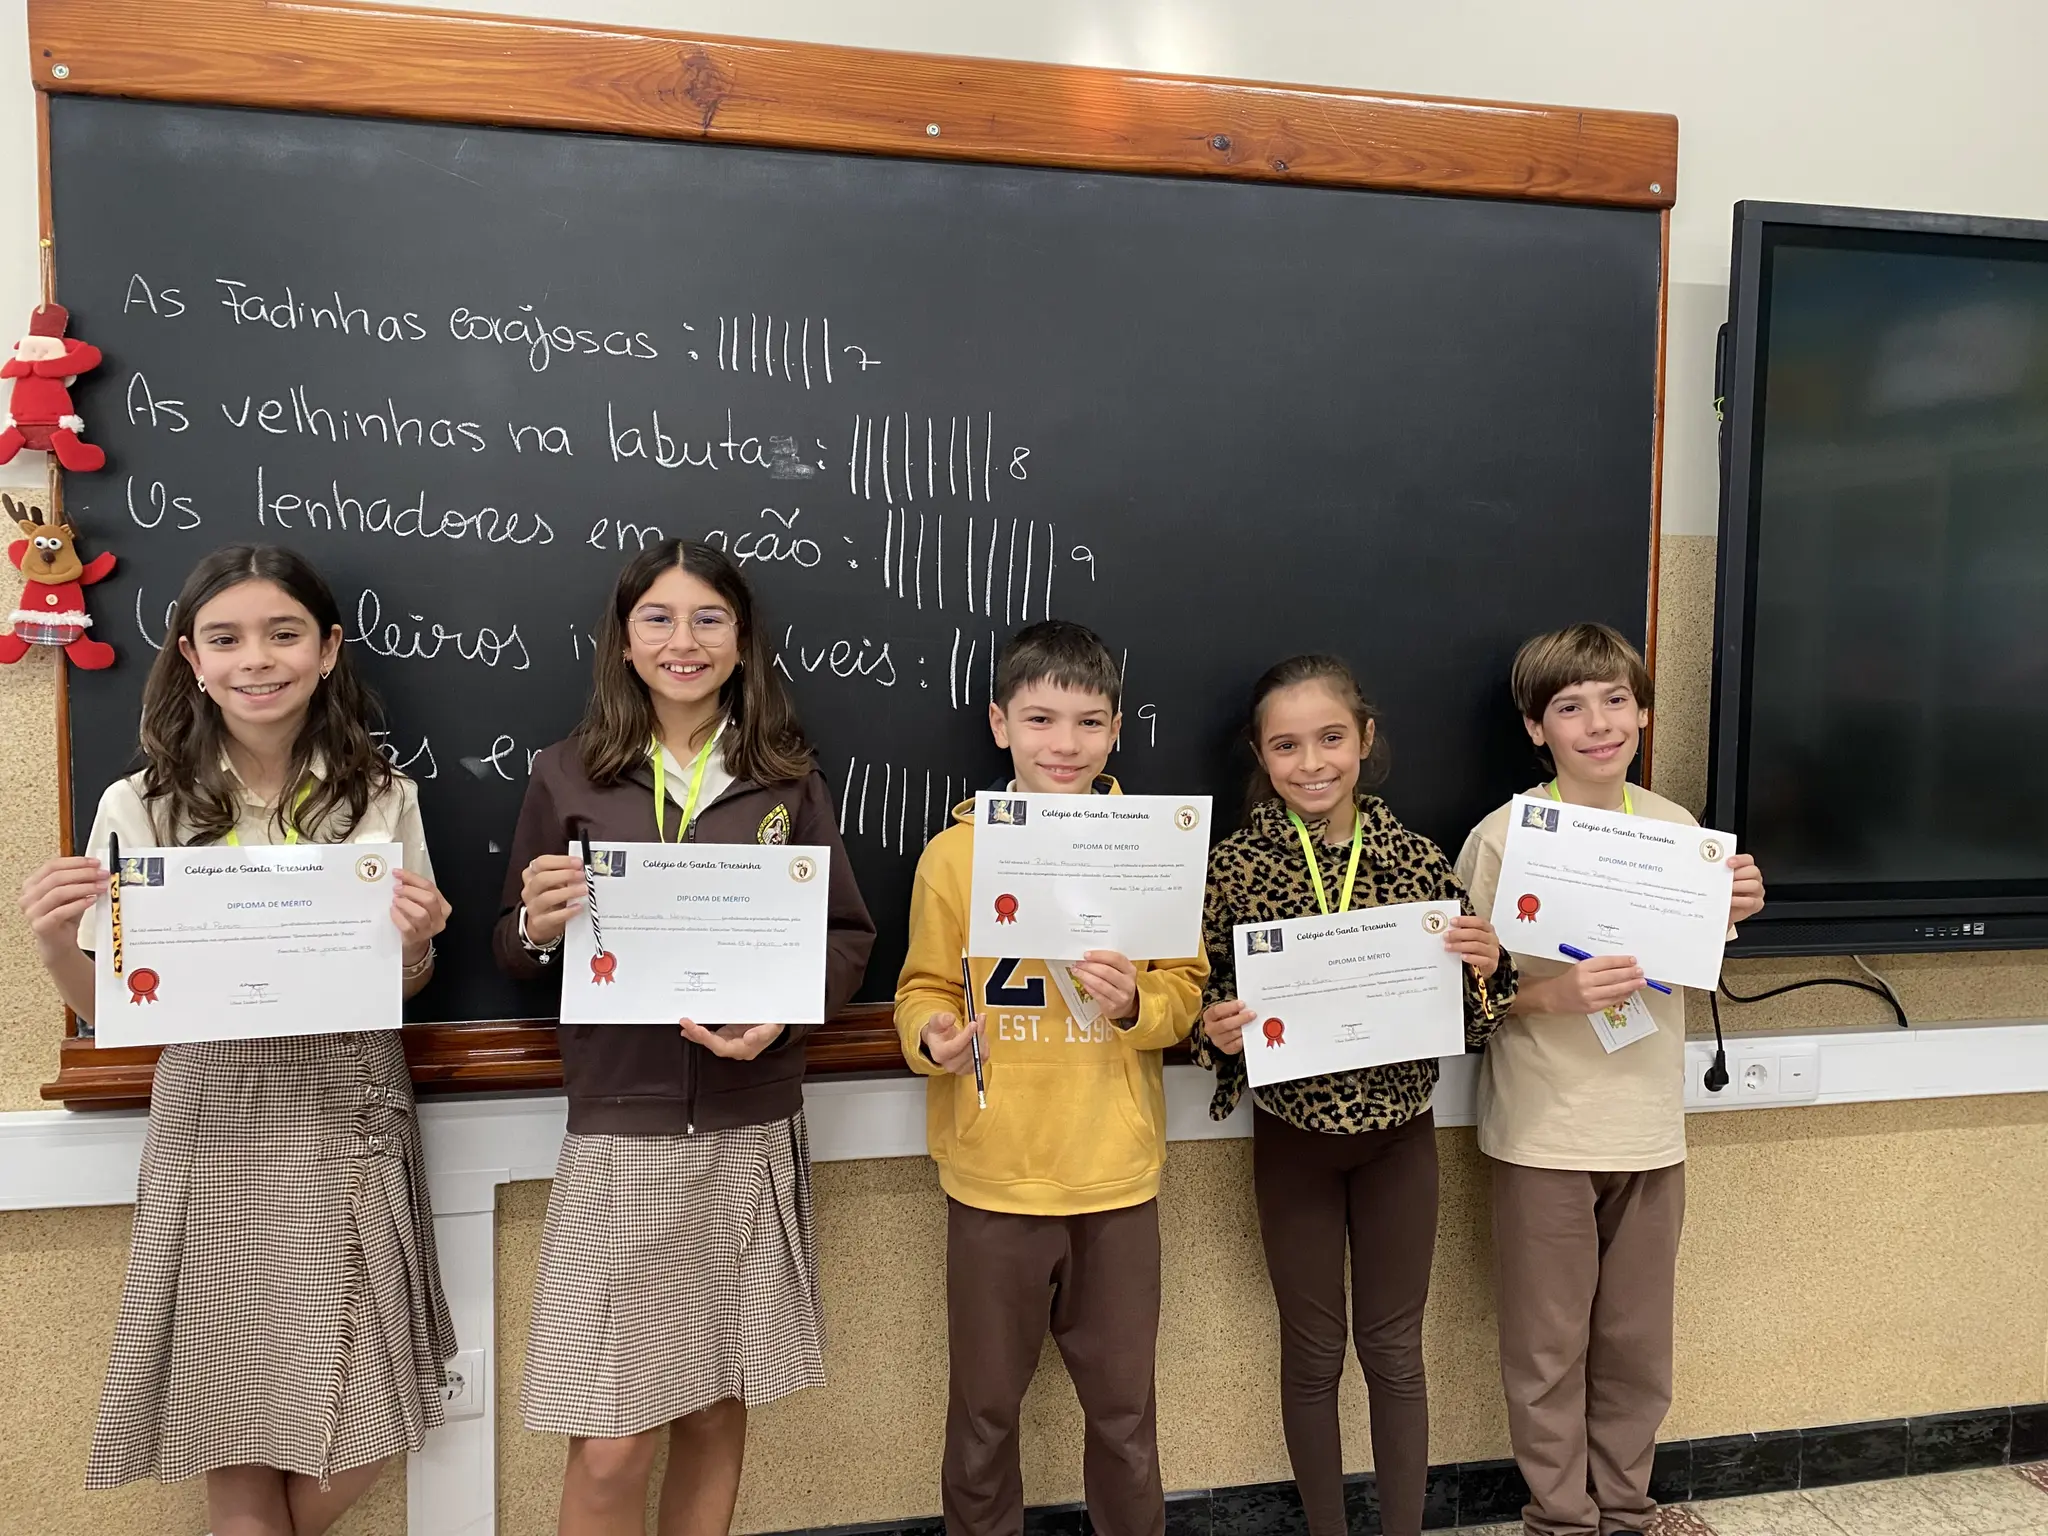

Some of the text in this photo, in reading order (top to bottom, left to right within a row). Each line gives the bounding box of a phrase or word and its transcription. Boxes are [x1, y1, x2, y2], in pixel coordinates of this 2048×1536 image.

[123, 273, 186, 318] As
[215, 278, 427, 342] Fadinhas
[843, 345, 882, 371] 7
[126, 371, 190, 433] As
[221, 384, 486, 453] velhinhas
[508, 422, 574, 456] na
[608, 400, 773, 471] labuta
[1009, 446, 1031, 481] 8
[257, 465, 555, 545] lenhadores
[585, 517, 664, 551] em
[702, 507, 822, 568] ação
[1070, 545, 1096, 582] 9
[1137, 703, 1157, 748] 9
[1041, 808, 1151, 820] Colégio de Santa Teresinha
[1572, 820, 1676, 845] Colégio de Santa Teresinha
[1104, 843, 1113, 851] DE
[1114, 842, 1140, 851] MÉRITO
[184, 863, 325, 877] Colégio de Santa Teresinha
[642, 859, 762, 871] Colégio de Santa Teresinha
[1598, 855, 1628, 866] DIPLOMA
[1638, 862, 1664, 873] MÉRITO
[227, 898, 313, 910] DIPLOMA DE MÉRITO
[711, 895, 721, 903] DE
[722, 894, 751, 903] MÉRITO
[1296, 921, 1398, 941] Colégio de Santa Teresinha
[1328, 957, 1357, 966] DIPLOMA
[1366, 951, 1391, 961] MÉRITO
[999, 1014, 1050, 1043] EST.
